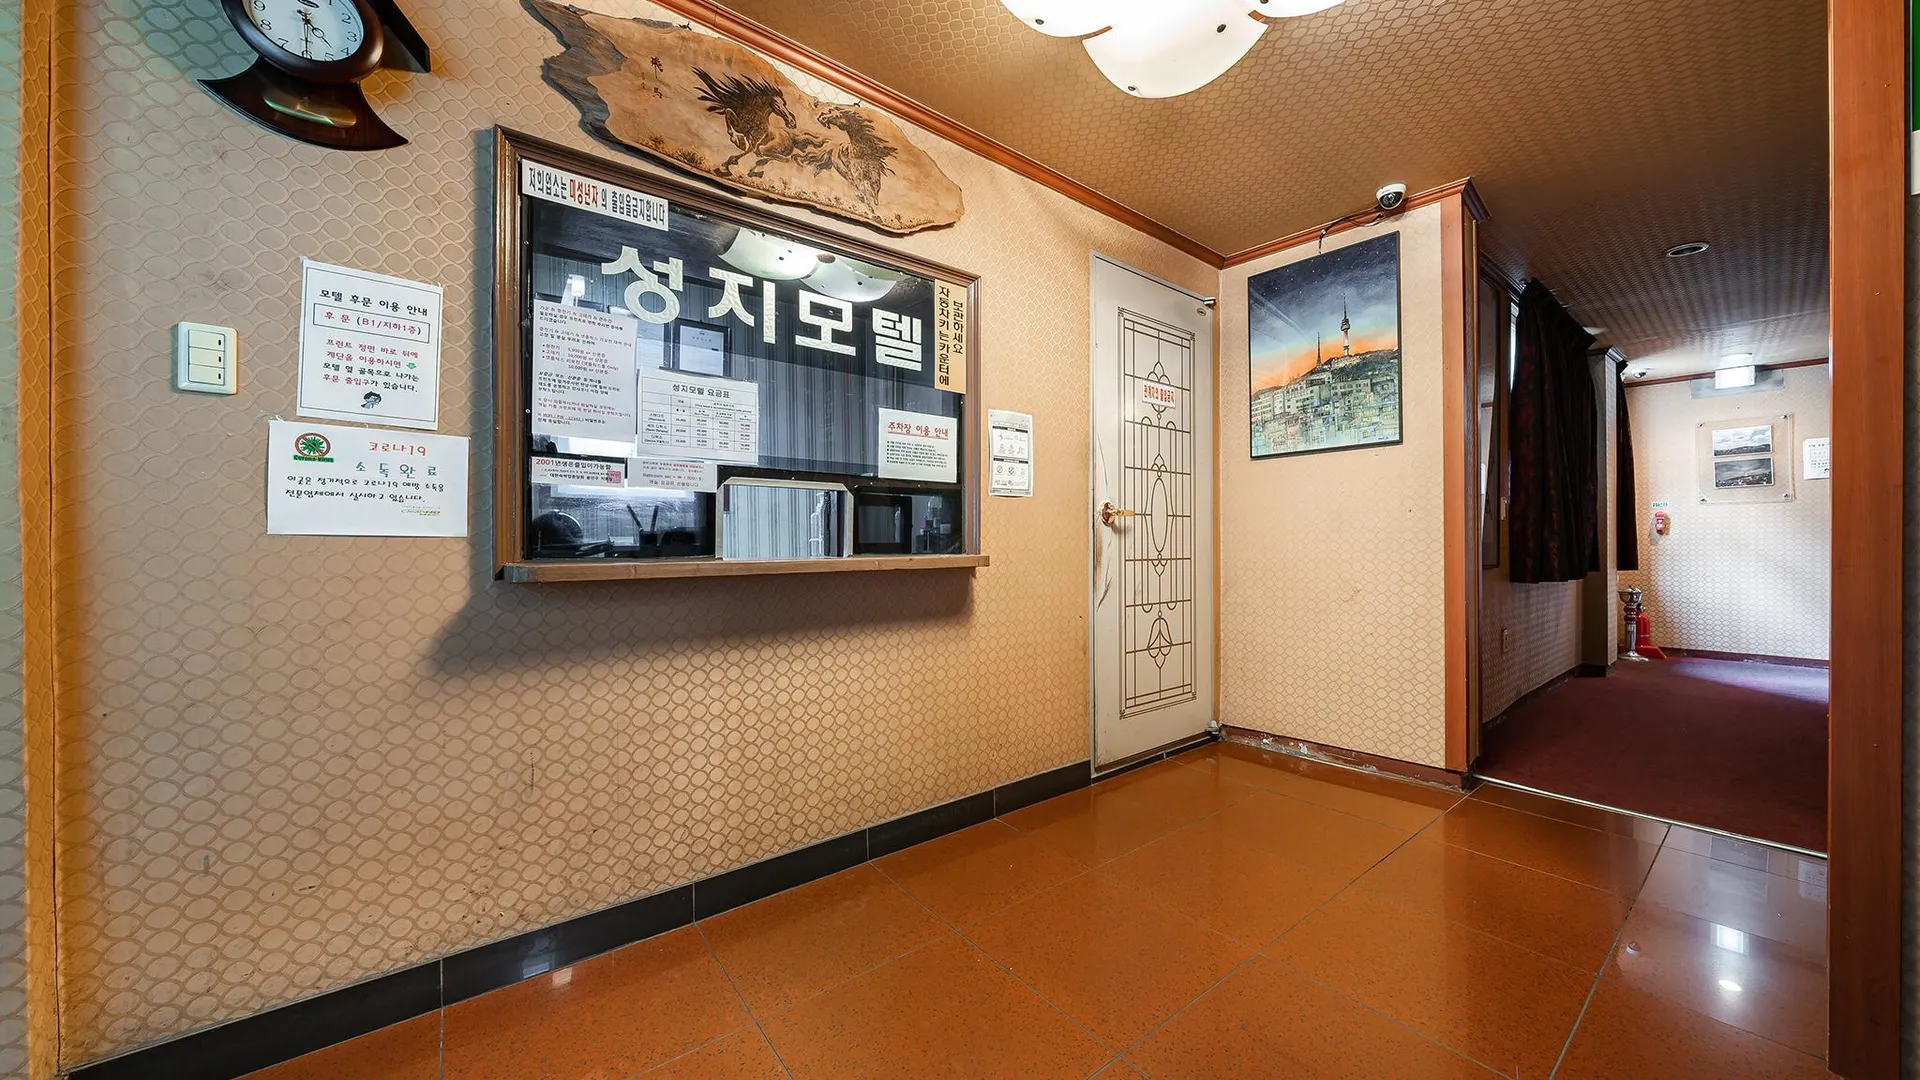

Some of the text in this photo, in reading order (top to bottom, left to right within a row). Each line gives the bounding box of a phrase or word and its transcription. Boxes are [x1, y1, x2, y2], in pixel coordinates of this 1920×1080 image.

[260, 18, 272, 31] 8
[341, 12, 352, 25] 2
[277, 37, 289, 49] 7
[346, 31, 358, 43] 3
[340, 46, 351, 57] 4
[528, 167, 666, 226] 저희업소는 미성년자 의 출입을금지합니다
[319, 289, 428, 317] 모텔 후문 이용 안내
[601, 244, 923, 373] 성지모텔
[324, 311, 421, 336] 후 문 (B1/지하1층)
[952, 299, 965, 355] 보관하세요
[326, 338, 419, 359] 프런트 정면 바로 뒤에
[326, 351, 401, 368] 계단을 이용하시면
[323, 362, 340, 372] 모텔
[358, 366, 391, 377] 골목으로
[395, 371, 420, 383] 나가는
[323, 373, 419, 393] 후문 출입구가 있습니다.
[672, 383, 730, 399] 성지모텔 요금표
[887, 420, 949, 438] 주차장 이용 안내
[368, 440, 427, 457] 코로나19
[355, 461, 437, 479] 소 독 완 료
[316, 476, 359, 487] 정기적으로
[363, 479, 399, 489] 코로나19
[402, 480, 420, 491] 예방
[424, 482, 445, 493] 소독을
[285, 488, 426, 504] 전문업체에서 실시하고 있습니다.
